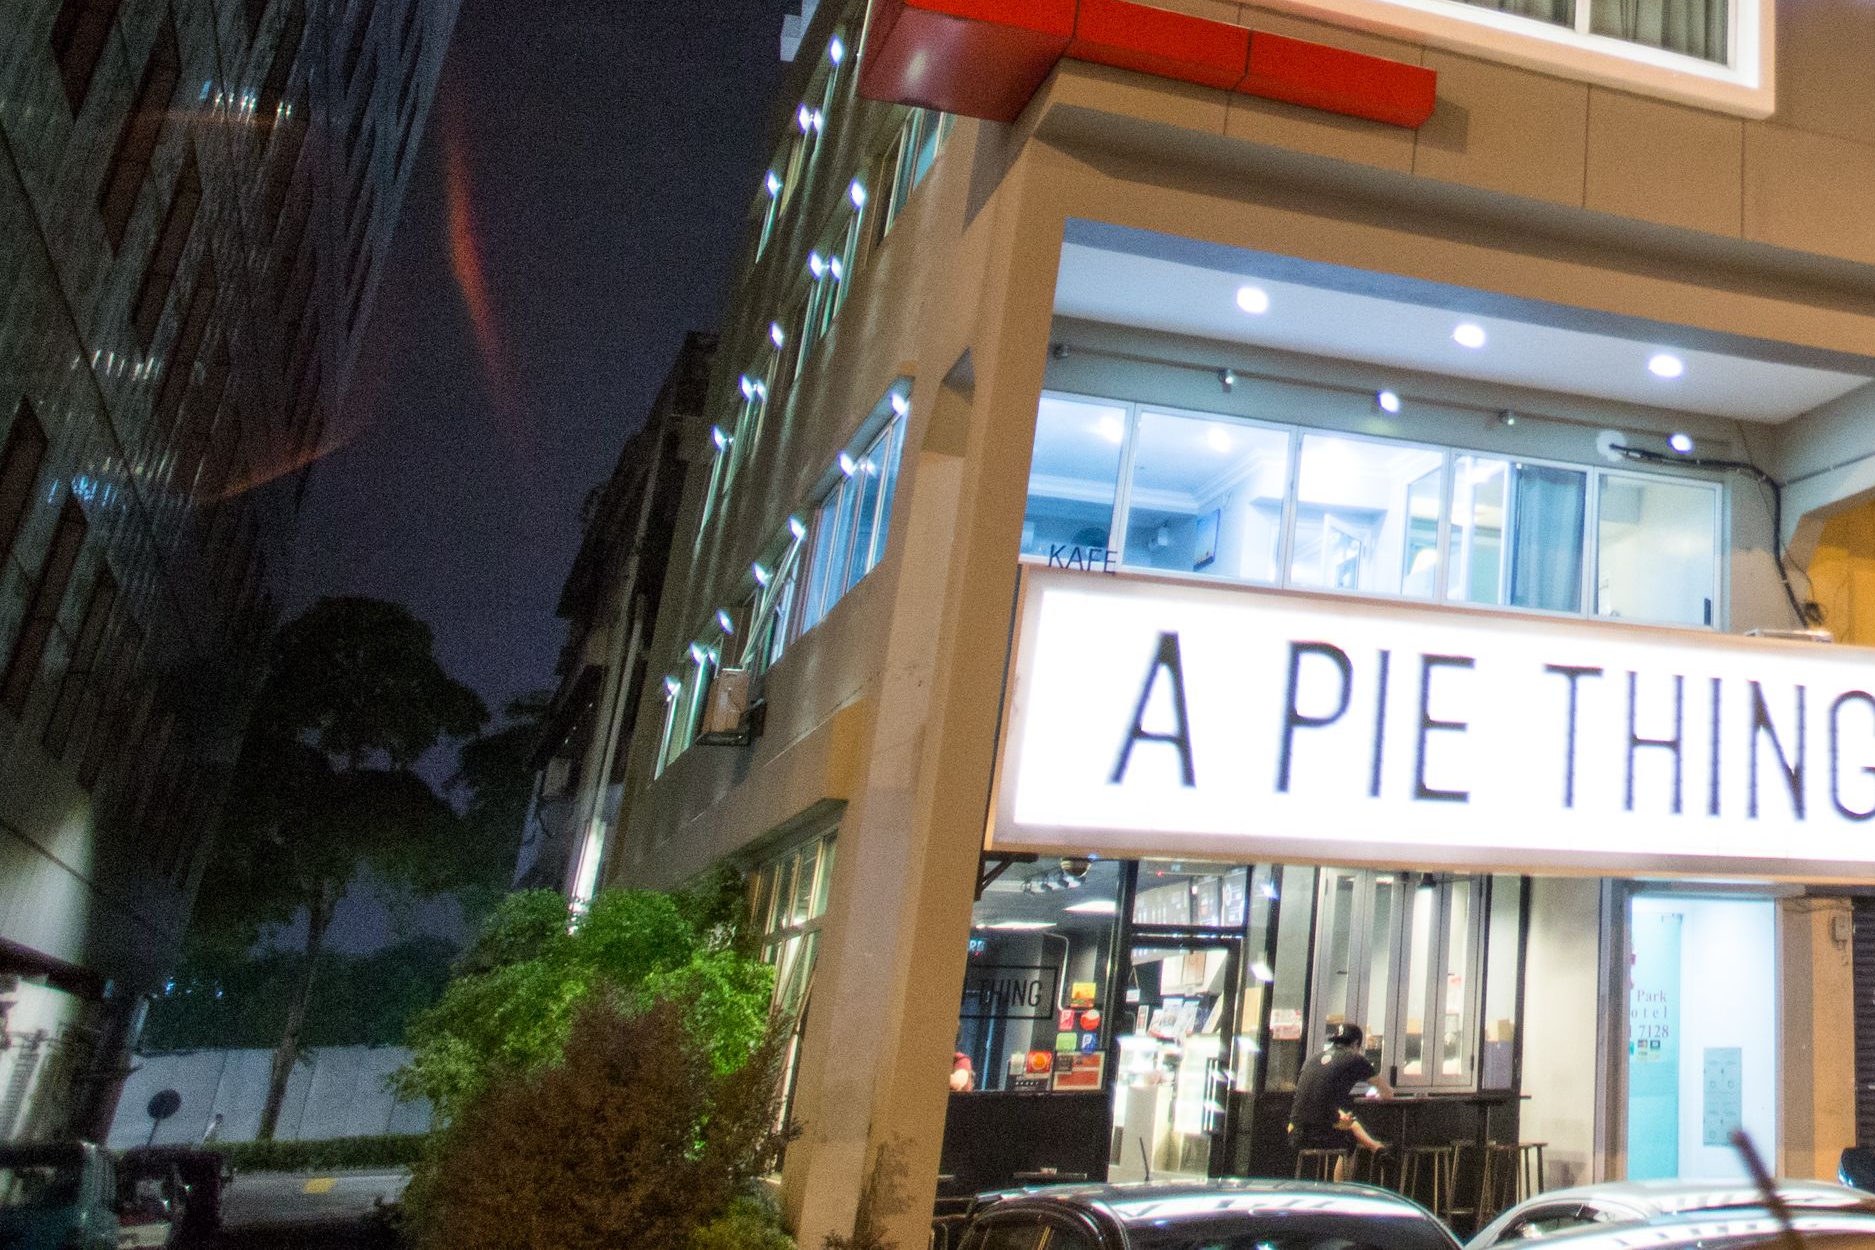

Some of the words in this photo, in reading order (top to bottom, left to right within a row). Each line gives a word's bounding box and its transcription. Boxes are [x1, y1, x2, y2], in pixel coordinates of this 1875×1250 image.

[1048, 544, 1119, 577] KAFE
[1108, 630, 1197, 790] A
[1275, 639, 1478, 804] PIE
[979, 978, 1044, 1009] THING
[1636, 988, 1668, 1003] Park
[1630, 1004, 1668, 1020] otel
[1638, 1024, 1670, 1039] 7128
